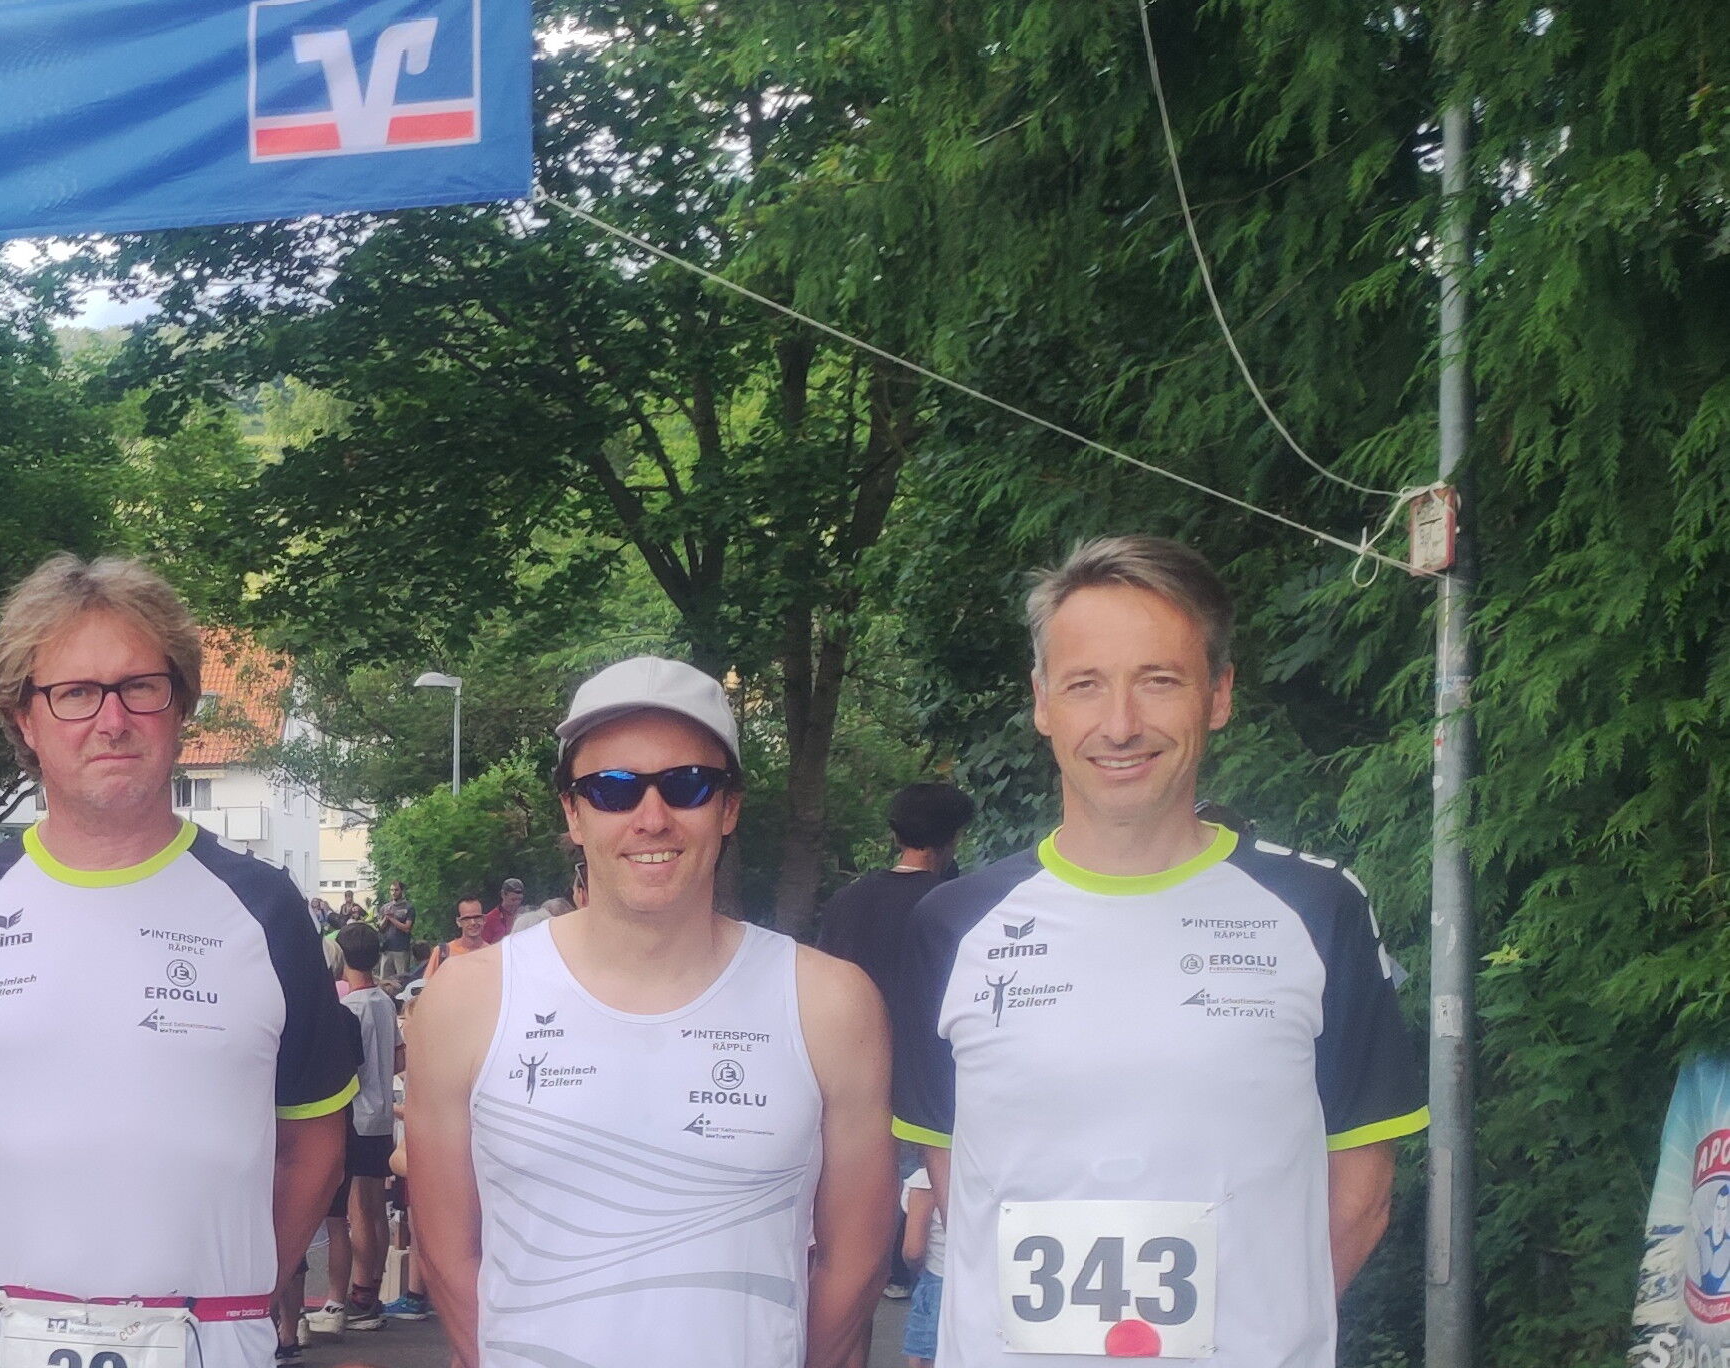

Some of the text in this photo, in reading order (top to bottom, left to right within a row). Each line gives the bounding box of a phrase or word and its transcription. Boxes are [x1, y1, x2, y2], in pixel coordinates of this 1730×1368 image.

[1194, 919, 1278, 930] INTERSPORT
[152, 930, 223, 948] INTERSPORT
[987, 943, 1047, 960] erima
[1210, 955, 1276, 967] EROGLU
[145, 987, 217, 1004] EROGLU
[974, 983, 1073, 1002] LG Steinlach
[1008, 996, 1057, 1009] Zollern
[526, 1028, 564, 1039] erima
[694, 1030, 770, 1042] INTERSPORT
[509, 1065, 597, 1079] LG Steinlach
[540, 1077, 583, 1087] Zollern
[689, 1091, 767, 1107] EROGLU
[1012, 1235, 1198, 1326] 343
